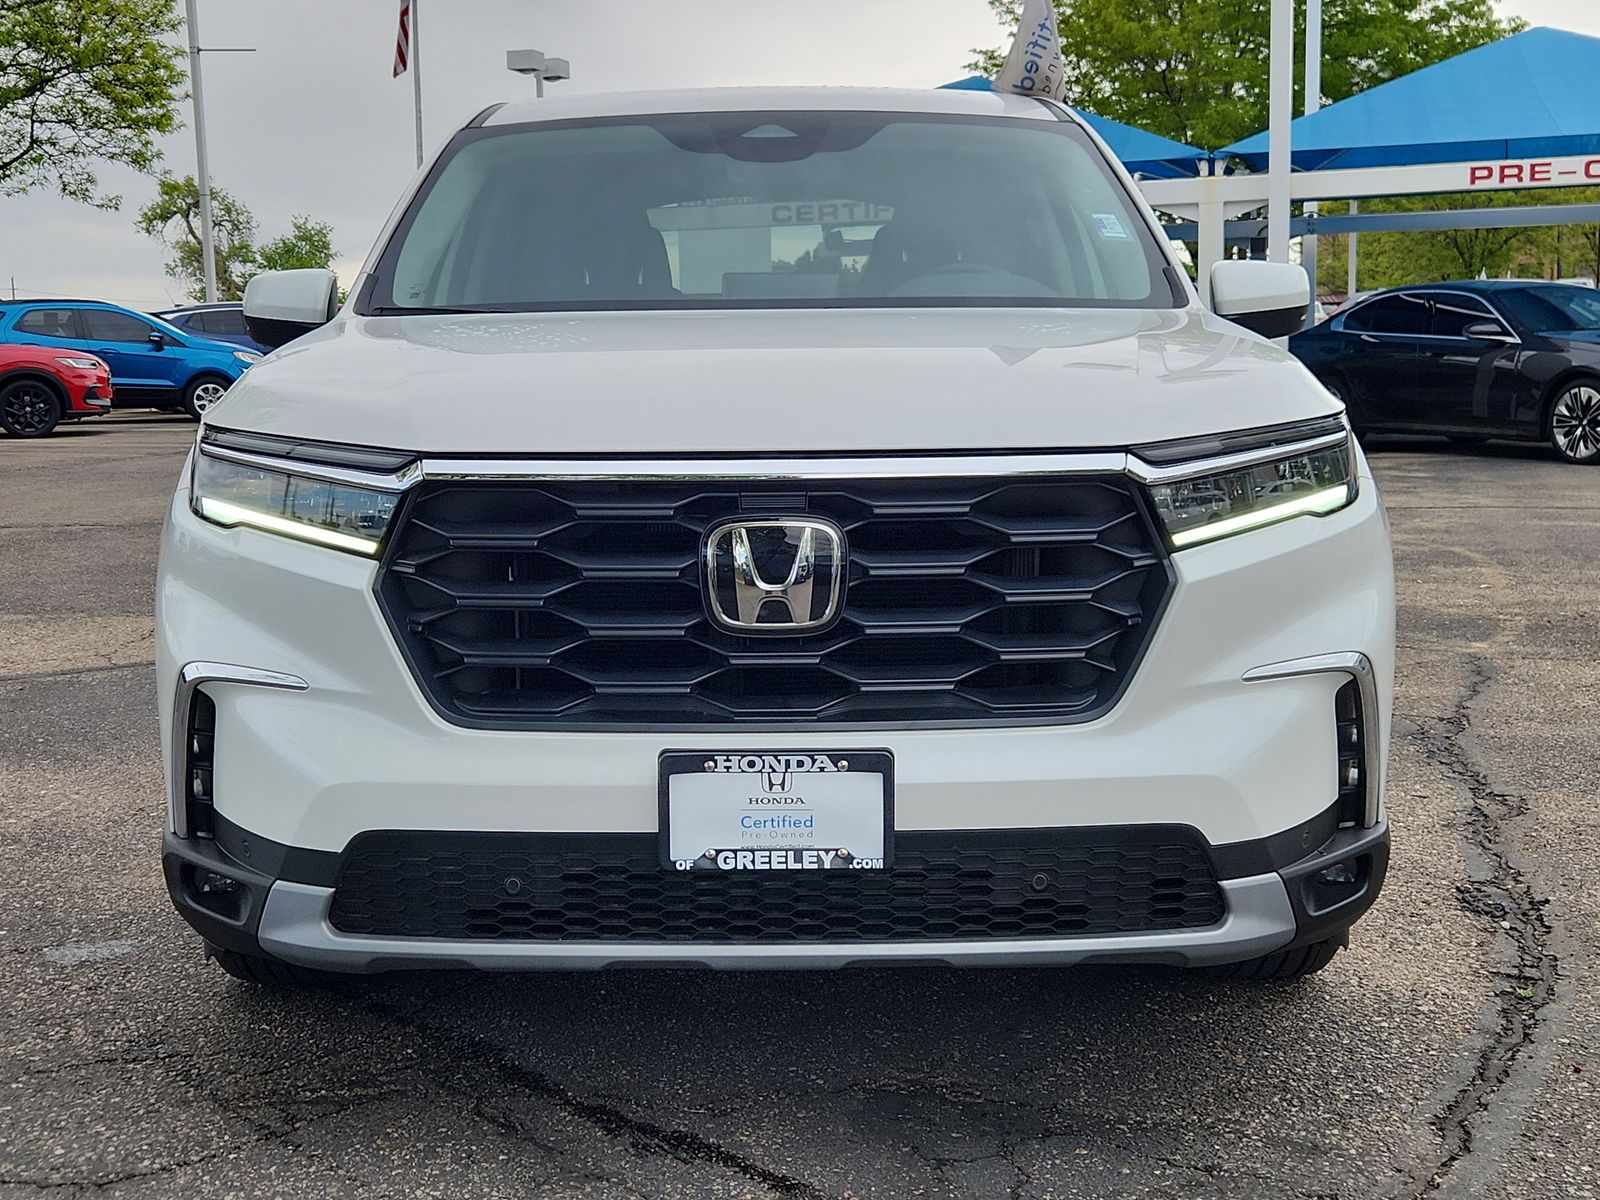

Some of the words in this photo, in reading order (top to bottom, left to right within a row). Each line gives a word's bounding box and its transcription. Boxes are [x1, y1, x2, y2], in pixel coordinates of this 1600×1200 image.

[713, 755, 838, 773] HONDA
[747, 797, 806, 805] HONDA
[740, 815, 814, 829] Certified
[741, 830, 814, 839] Pre-Owned
[675, 859, 695, 871] OF
[716, 850, 837, 870] GREELEY
[848, 858, 884, 870] .COM
